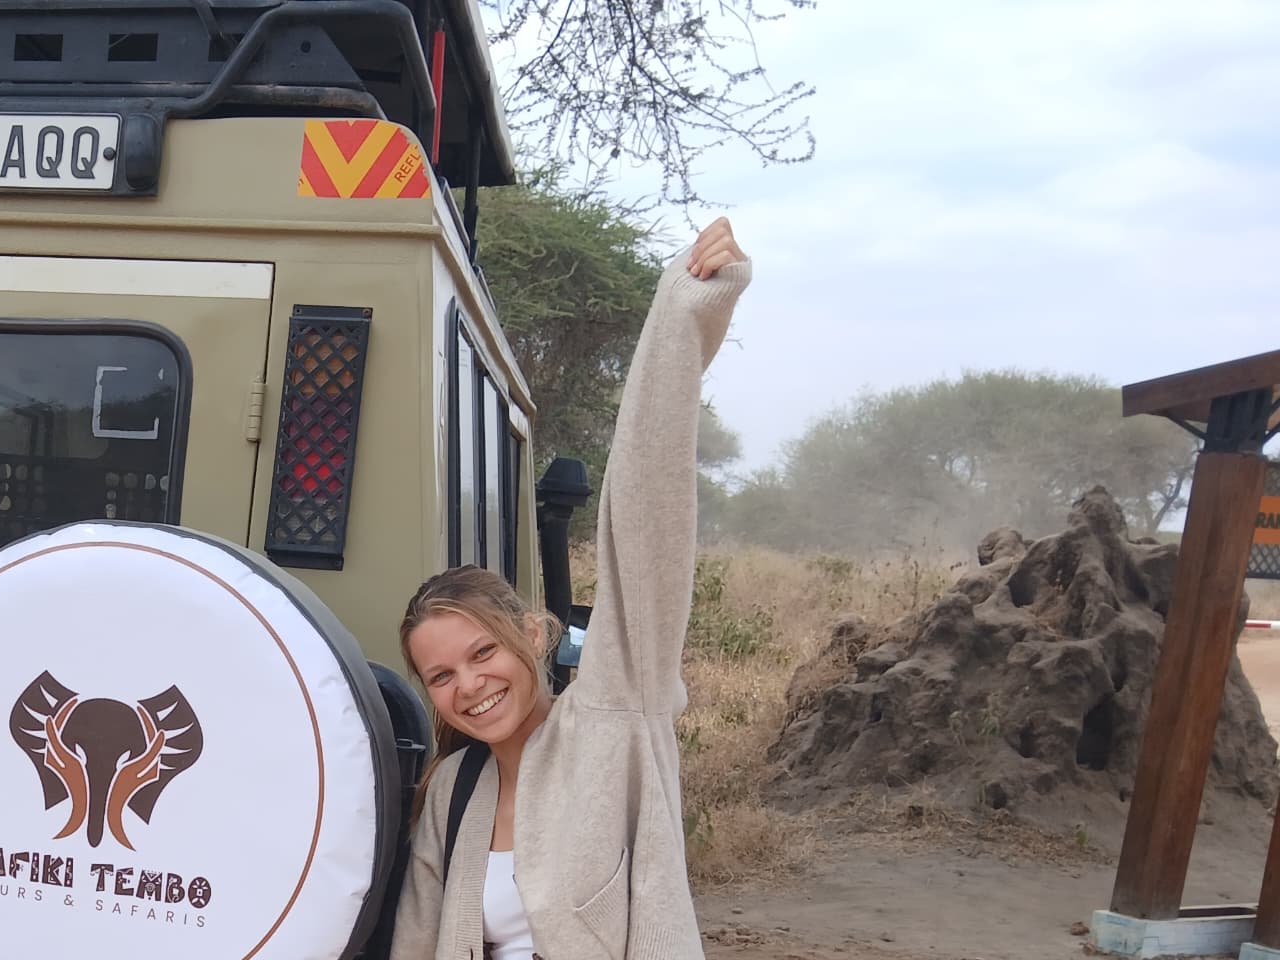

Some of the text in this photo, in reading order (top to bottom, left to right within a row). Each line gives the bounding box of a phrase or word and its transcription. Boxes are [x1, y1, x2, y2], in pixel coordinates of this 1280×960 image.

[0, 125, 100, 179] AQQ
[90, 863, 212, 909] TEMBO
[63, 894, 74, 907] &
[95, 899, 206, 928] SAFARIS
